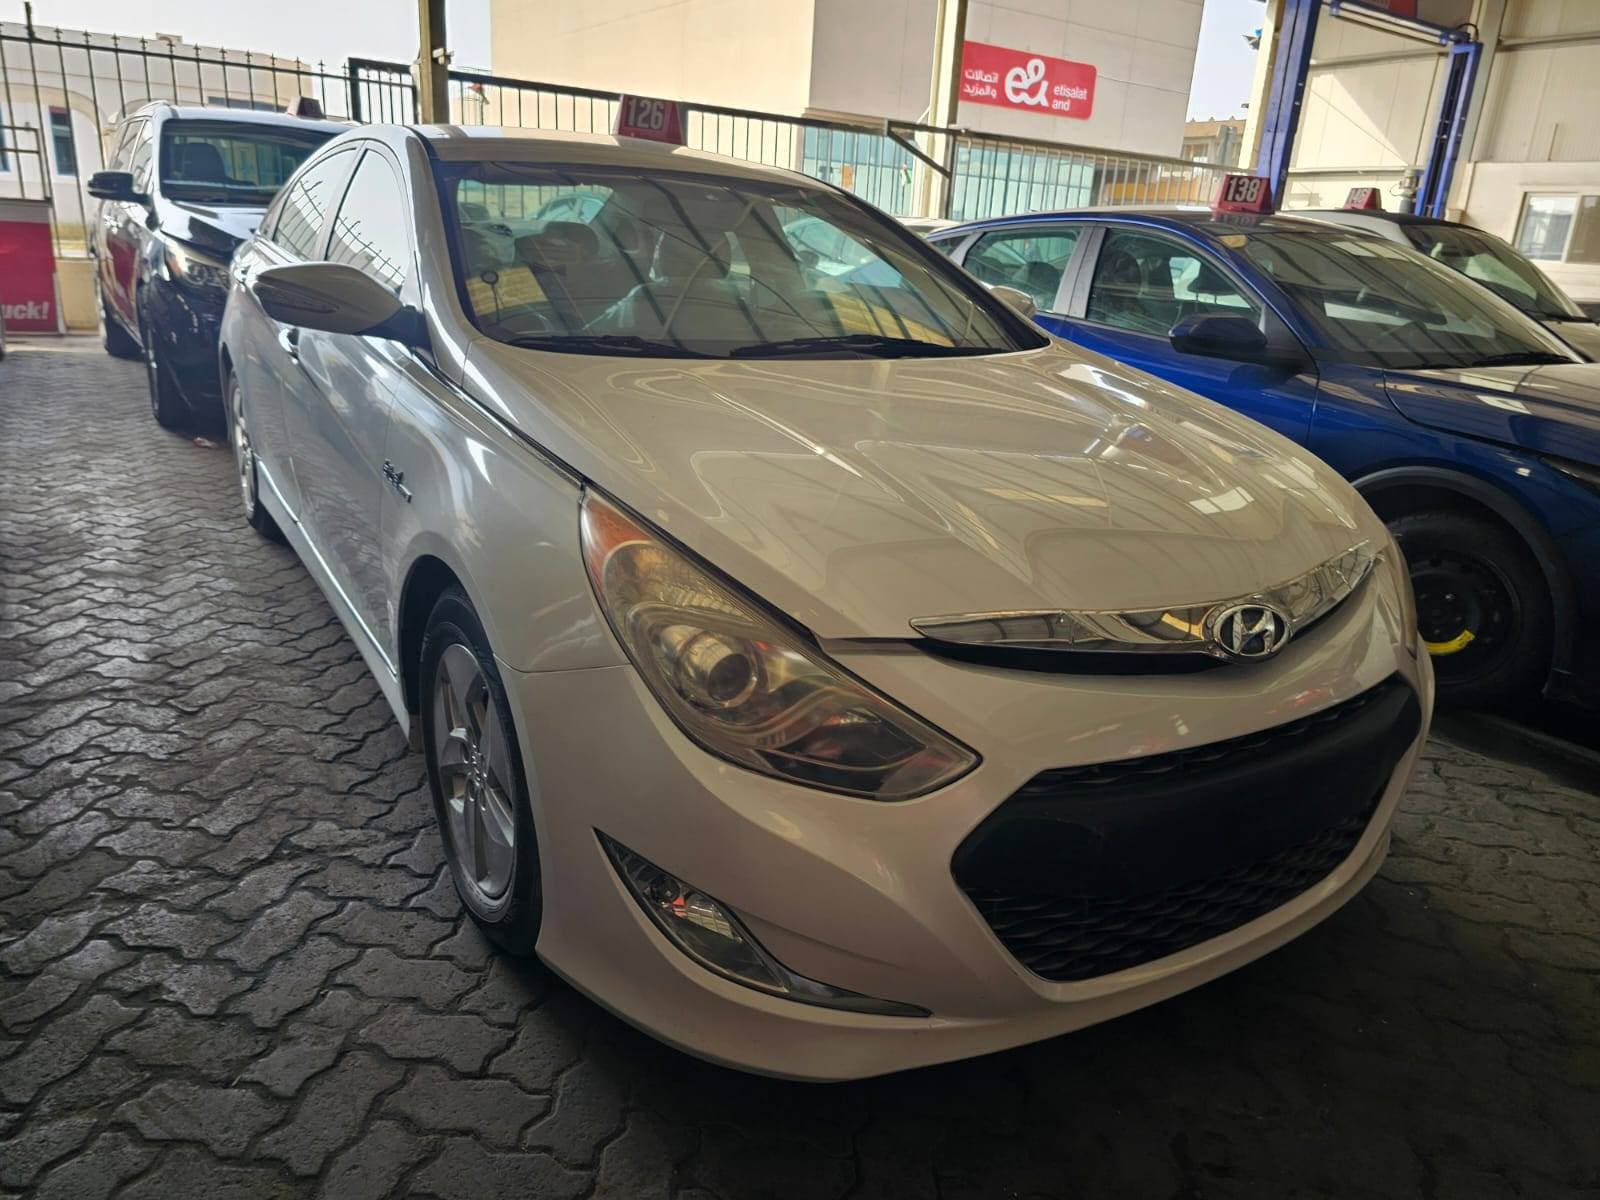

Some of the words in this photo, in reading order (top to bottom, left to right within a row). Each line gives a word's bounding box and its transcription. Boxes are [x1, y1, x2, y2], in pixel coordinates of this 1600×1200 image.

[1053, 84, 1088, 100] etisalat
[628, 98, 665, 130] 126
[1052, 99, 1071, 111] and
[1227, 178, 1260, 202] 138
